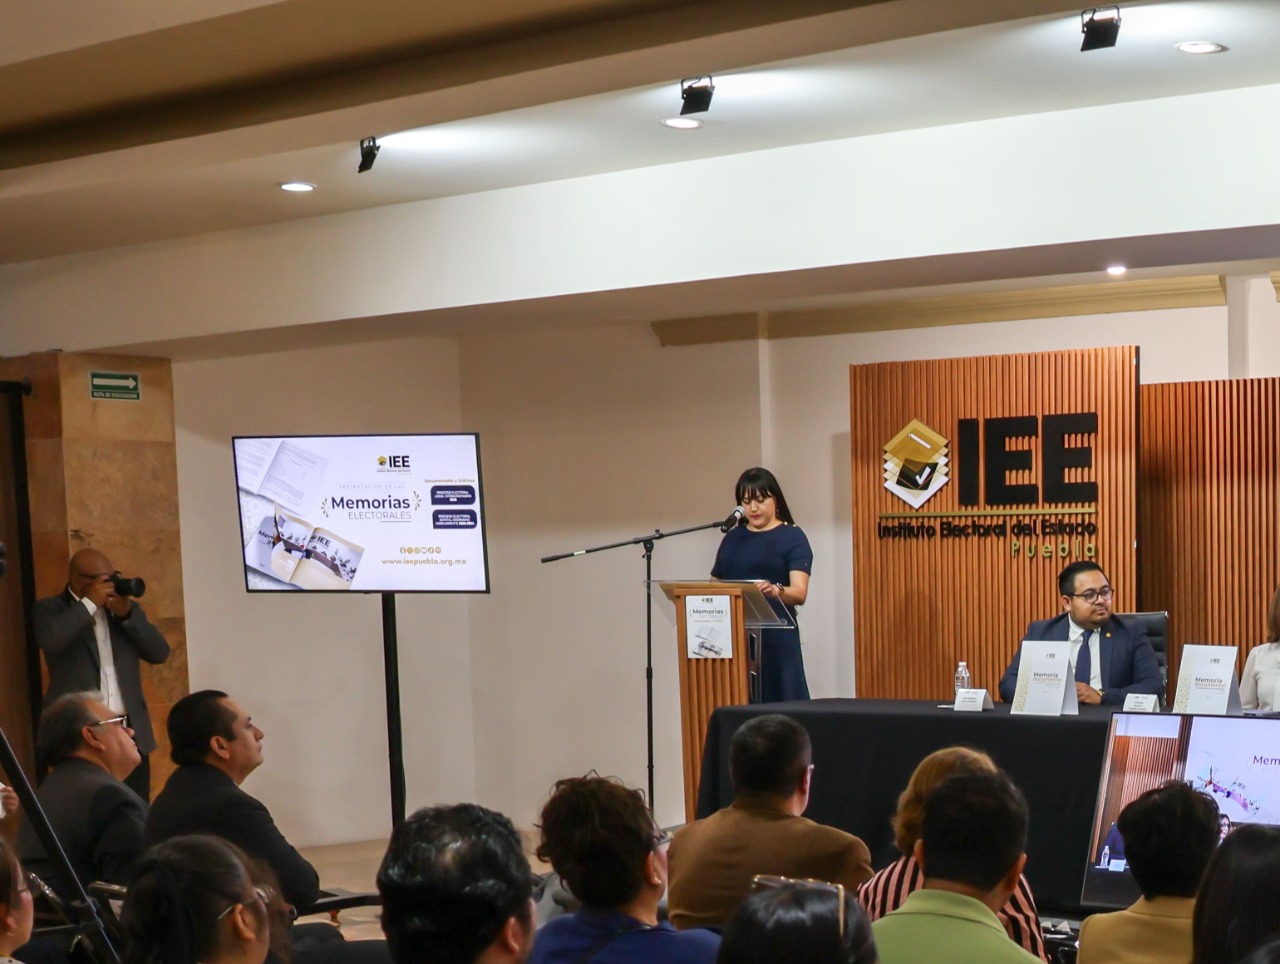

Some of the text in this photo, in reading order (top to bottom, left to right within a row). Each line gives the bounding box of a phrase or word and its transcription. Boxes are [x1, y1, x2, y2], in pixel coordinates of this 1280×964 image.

[388, 455, 410, 468] IEE
[958, 411, 1098, 506] IEE
[331, 494, 410, 509] Memorias
[348, 511, 412, 520] ELECTORALES
[878, 518, 1097, 540] Instituto Electoral del Estado
[1011, 540, 1096, 558] Puebla
[381, 557, 467, 566] www.ieepuebla.org.mx
